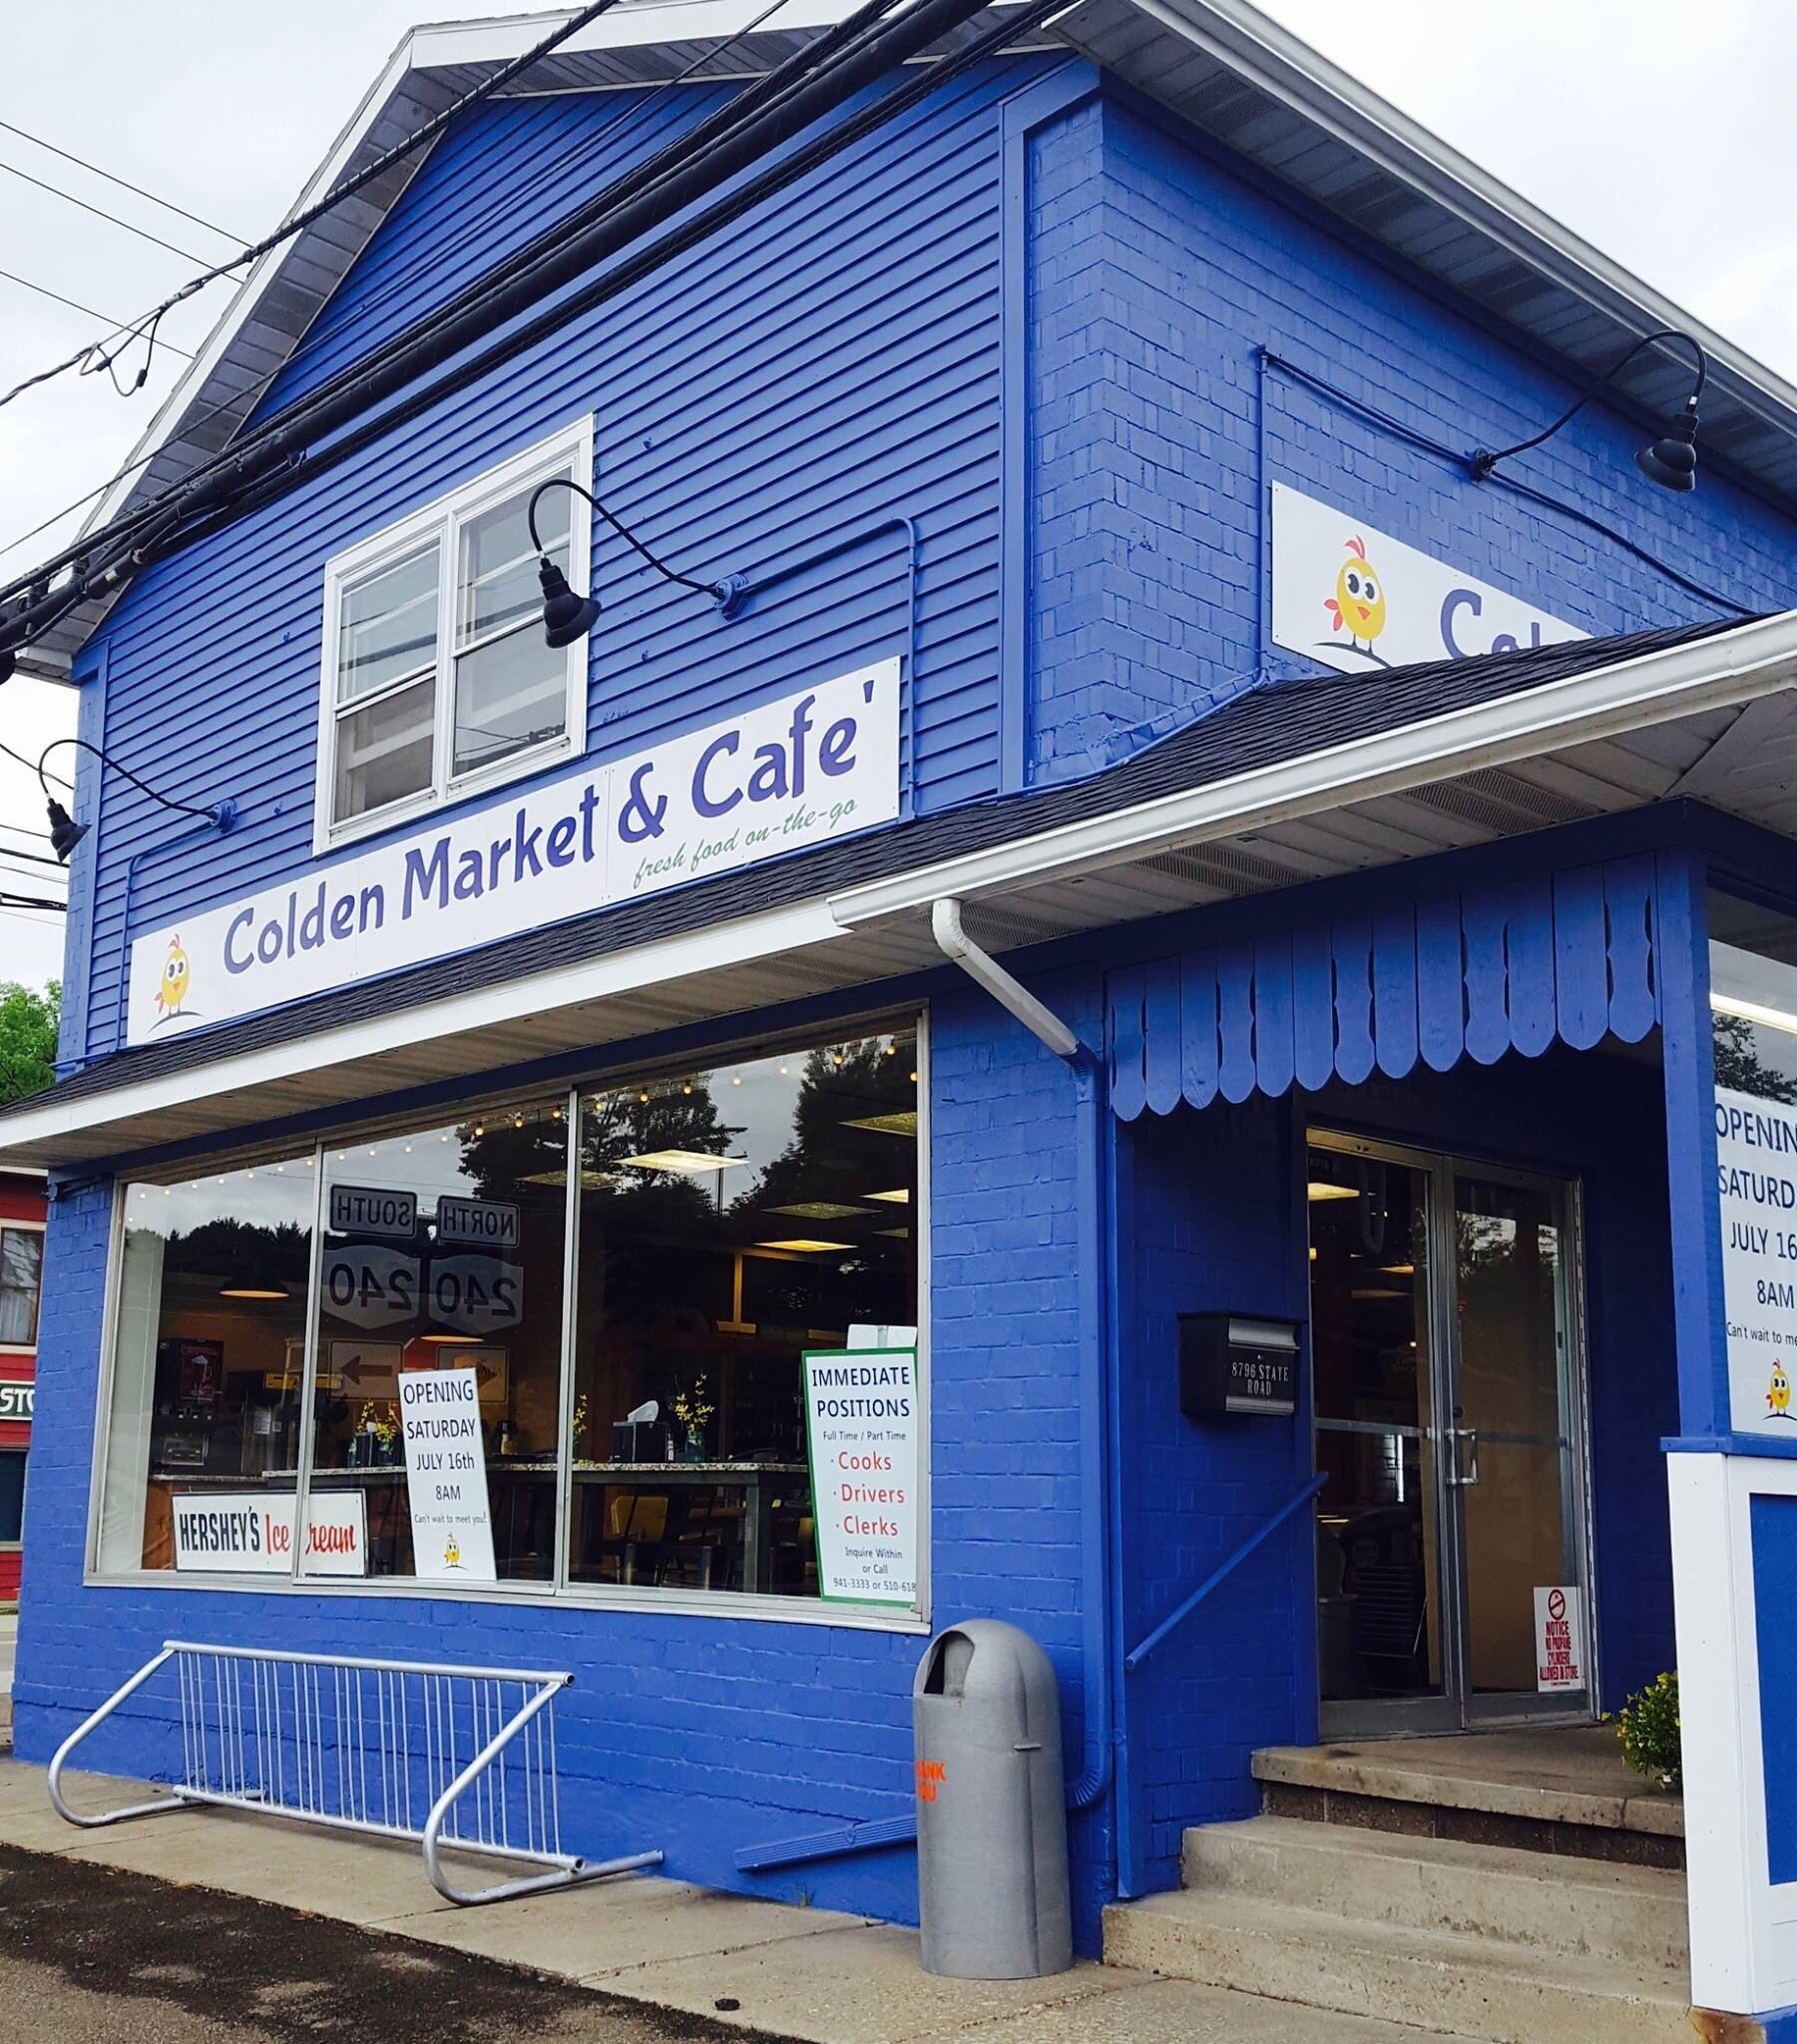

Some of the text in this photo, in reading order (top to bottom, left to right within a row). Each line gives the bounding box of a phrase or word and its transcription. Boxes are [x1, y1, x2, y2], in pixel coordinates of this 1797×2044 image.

[633, 798, 858, 889] fresh food on-the-go
[224, 880, 384, 974] Colden
[402, 784, 600, 920] Market
[618, 762, 668, 843] &
[1730, 1222, 1768, 1255] JULY
[1757, 1278, 1795, 1309] 8AM
[1726, 1321, 1748, 1339] Can't
[1750, 1327, 1770, 1342] wait
[1772, 1330, 1782, 1344] to
[812, 1366, 910, 1386] IMMEDIATE
[1231, 1361, 1289, 1381] 8796 STATE
[403, 1379, 474, 1404] OPENING
[1247, 1379, 1271, 1395] ROAD
[817, 1398, 910, 1417] POSITIONS
[407, 1418, 476, 1439] SATURDAY
[823, 1430, 836, 1440] Full
[839, 1430, 858, 1440] Time
[867, 1430, 883, 1441] Part
[886, 1430, 906, 1441] Time
[416, 1451, 475, 1470] JULY 16th
[838, 1451, 892, 1470] Cooks
[435, 1485, 461, 1501] 8AM
[841, 1483, 905, 1503] Drivers
[414, 1513, 430, 1524] Can't
[432, 1514, 446, 1524] wait
[447, 1515, 454, 1524] to
[455, 1515, 471, 1524] meet
[843, 1515, 899, 1536] Clerks
[179, 1506, 357, 1555] HERSHEY'S Ice ream
[845, 1547, 903, 1559] Inquire Within
[873, 1564, 888, 1574] Call
[873, 1581, 881, 1590] or
[1546, 1621, 1570, 1636] NOTICE
